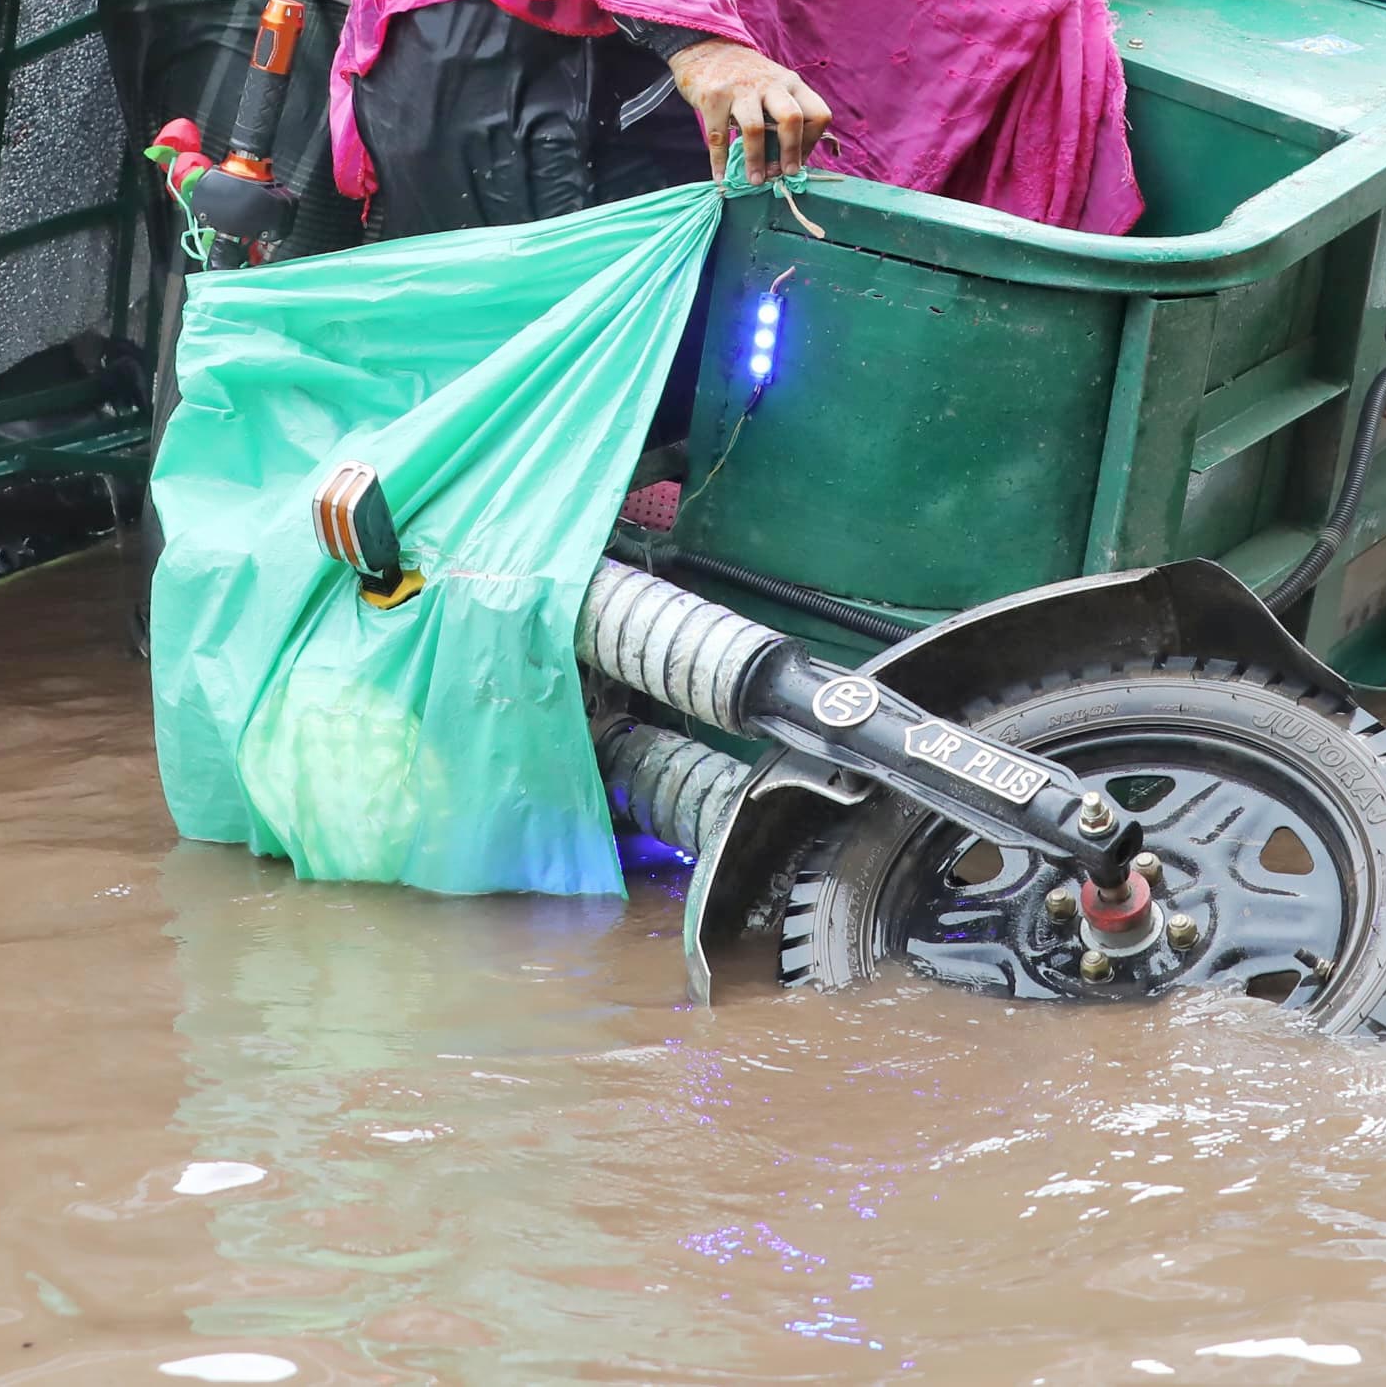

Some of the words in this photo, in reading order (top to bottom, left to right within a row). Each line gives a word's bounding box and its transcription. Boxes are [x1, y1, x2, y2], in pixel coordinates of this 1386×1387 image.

[823, 682, 871, 721] JR
[1048, 702, 1119, 728] NYLON
[918, 731, 962, 763] JR
[963, 749, 1037, 797] PLUS
